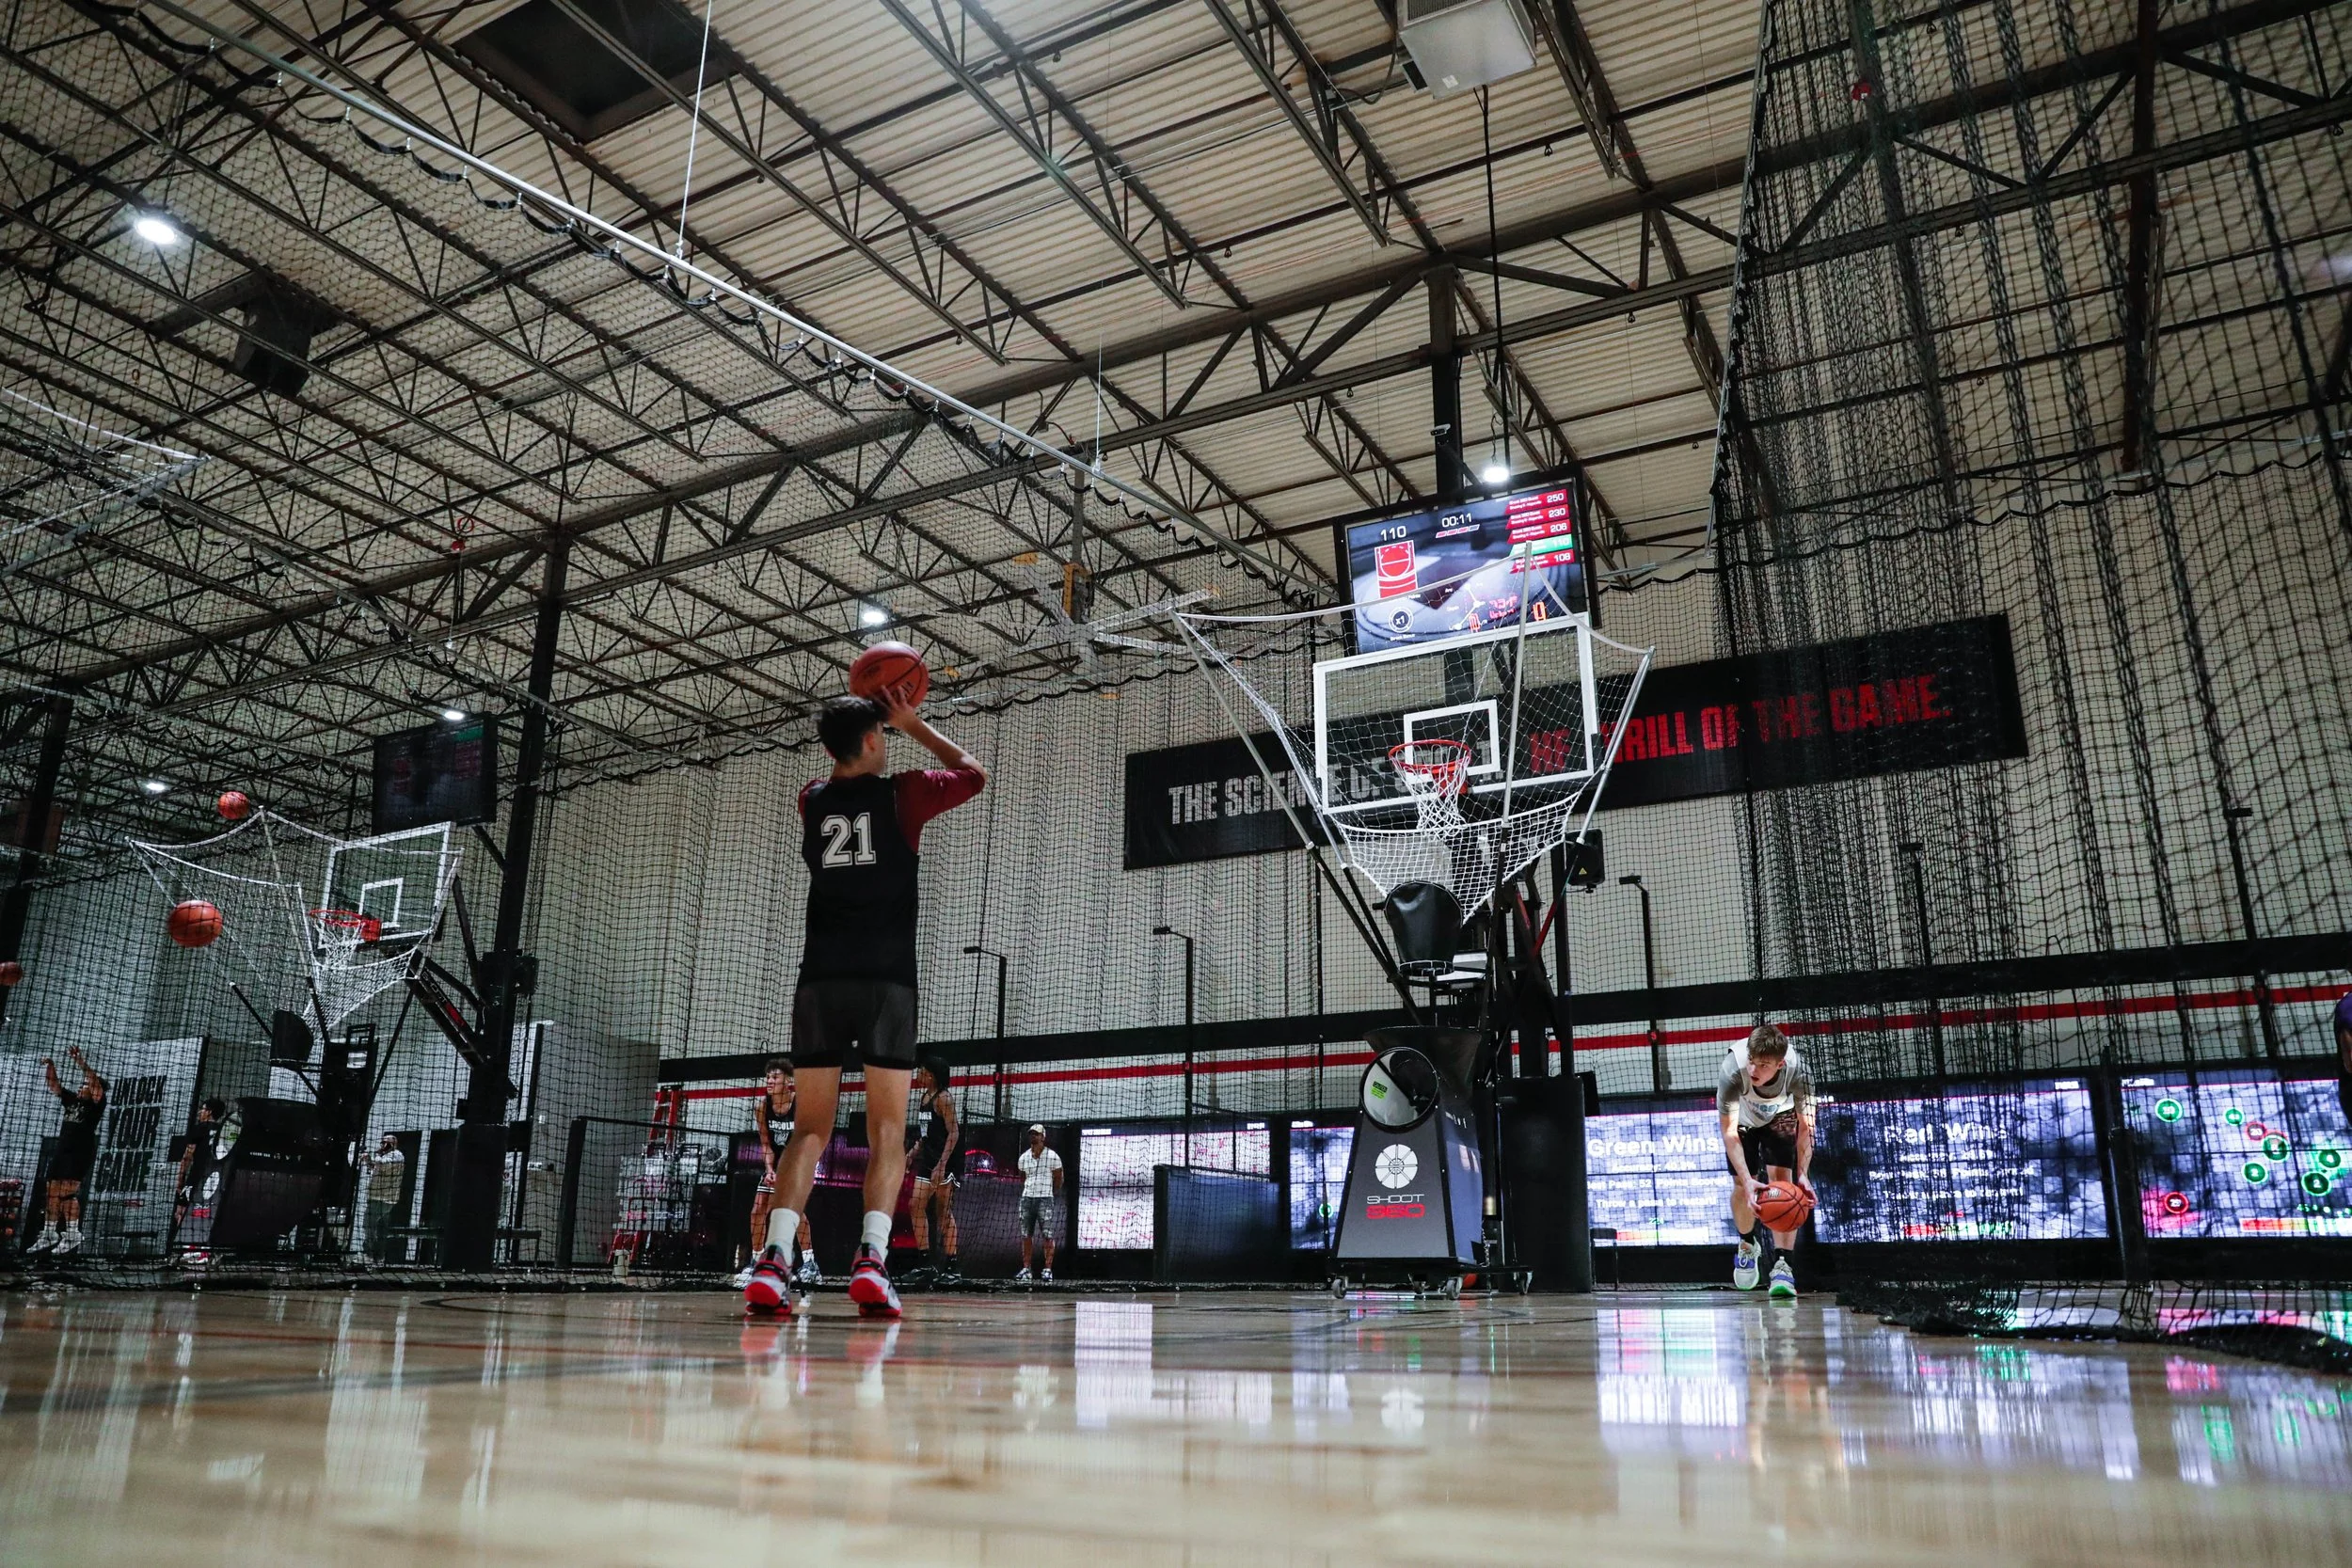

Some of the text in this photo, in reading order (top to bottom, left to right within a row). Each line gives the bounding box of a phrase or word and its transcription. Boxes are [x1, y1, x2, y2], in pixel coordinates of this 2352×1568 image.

[1547, 493, 1564, 503] 250
[1441, 513, 1473, 528] 00:11
[1549, 508, 1565, 518] 230
[1380, 526, 1407, 542] 110
[1554, 552, 1571, 562] 108
[1395, 614, 1406, 625] x1
[1752, 693, 1822, 744] THE
[1830, 673, 1952, 734] GAME.
[1168, 782, 1218, 825] THE
[1225, 763, 1343, 817] SCIENE
[820, 812, 877, 868] 21
[111, 1075, 167, 1106] UNLOCK
[107, 1107, 161, 1149] YOUR
[1587, 1133, 1720, 1158] Green Wins
[95, 1150, 154, 1193] GAME
[1639, 1179, 1652, 1188] 52
[1367, 1194, 1424, 1204] SHOOT
[1597, 1199, 1626, 1208] Throw
